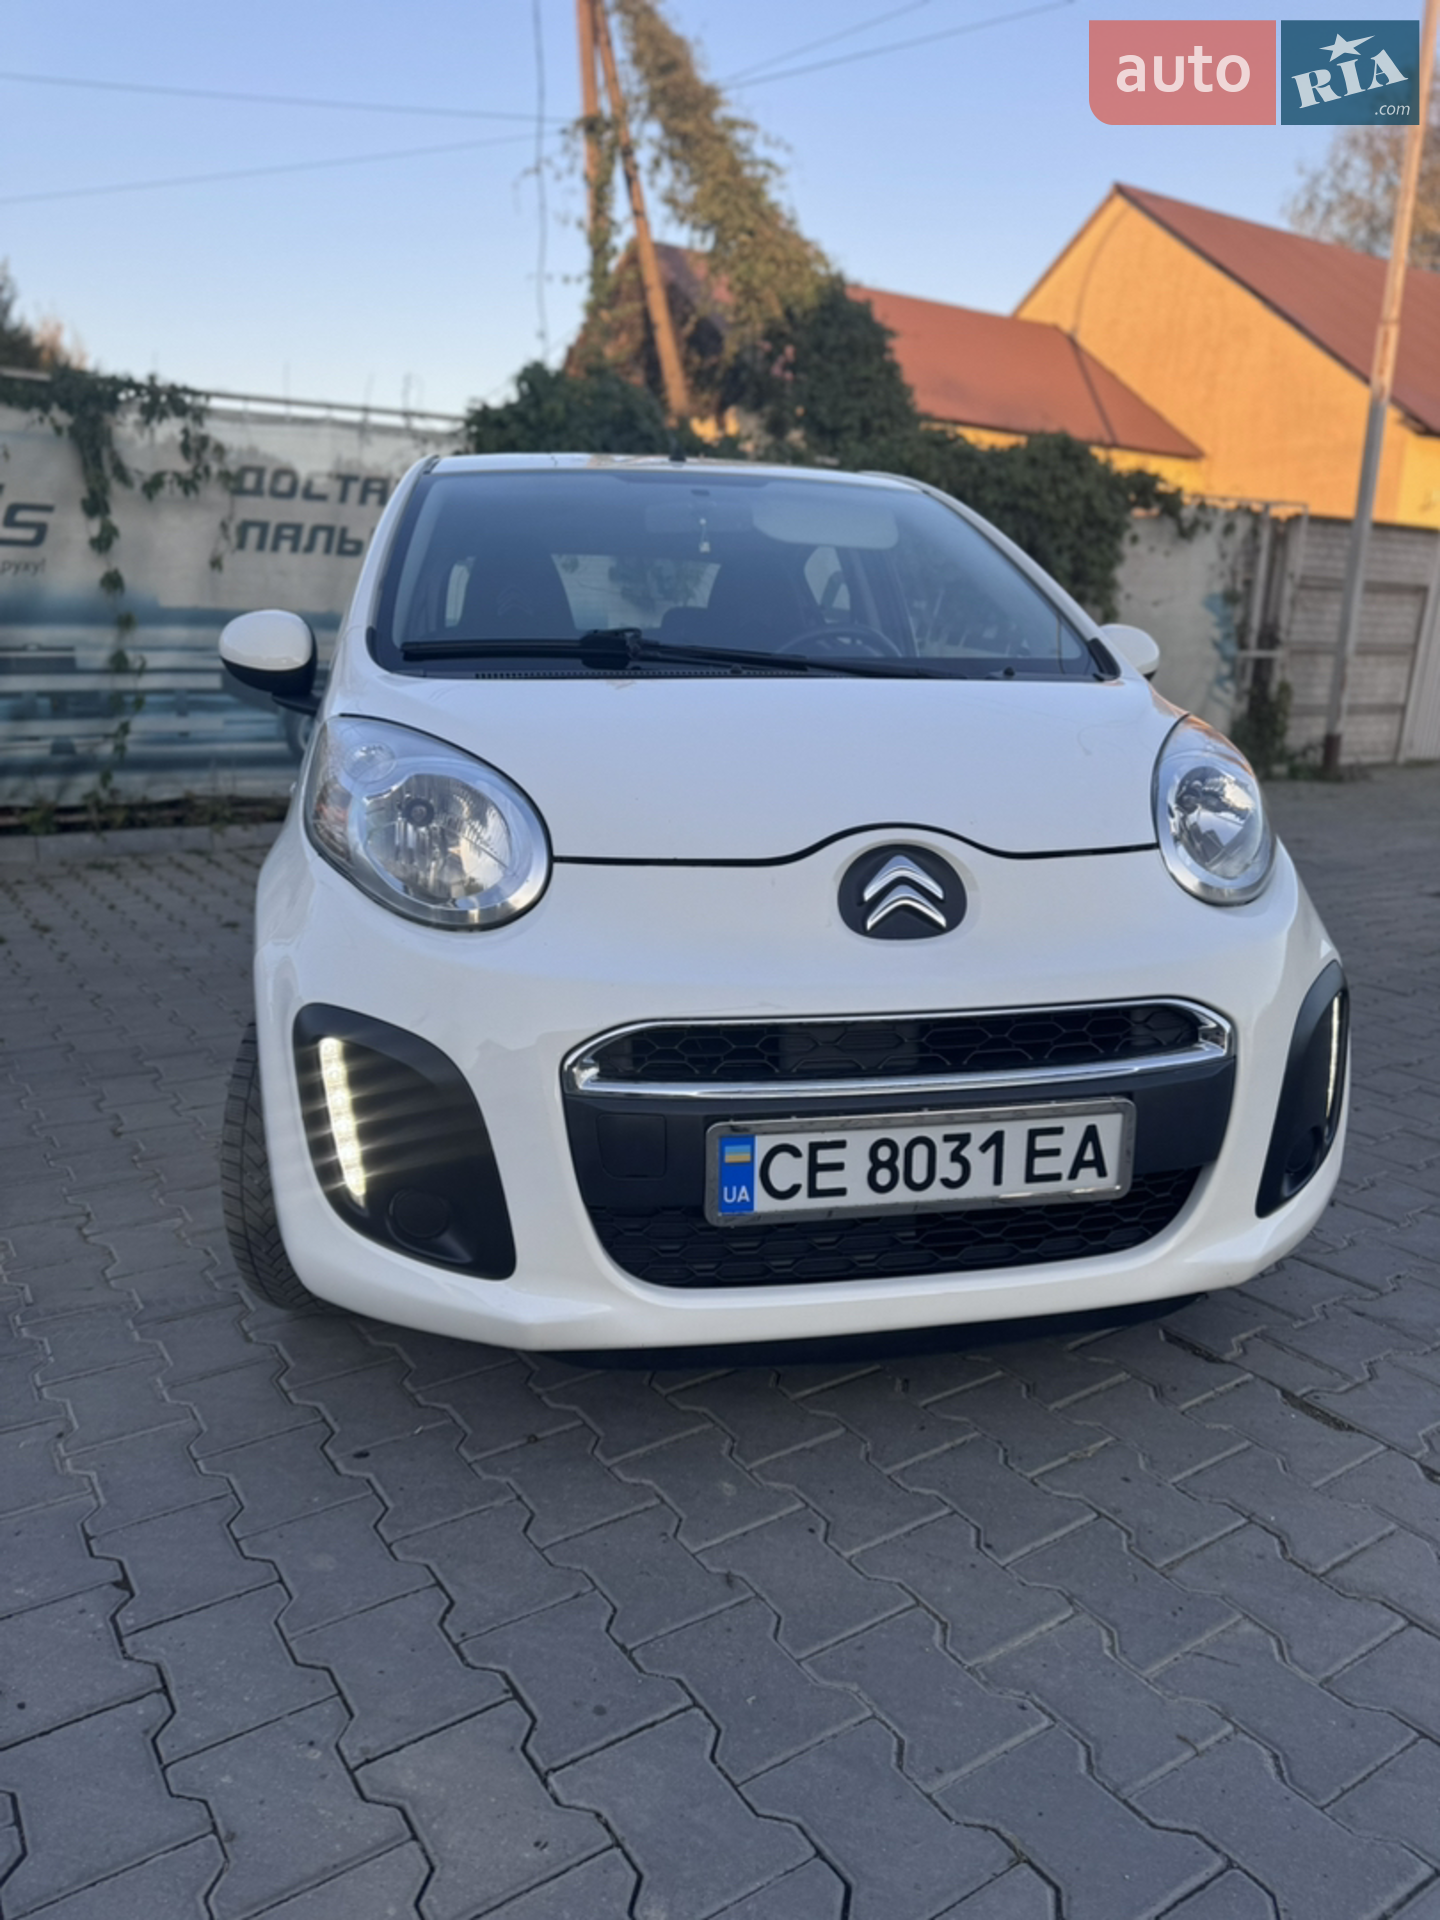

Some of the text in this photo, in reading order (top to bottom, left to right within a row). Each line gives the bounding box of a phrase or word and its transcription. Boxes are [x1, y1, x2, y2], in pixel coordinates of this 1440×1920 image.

[231, 465, 400, 507] ДОСТА
[236, 519, 374, 557] ПАЛЬ
[759, 1124, 1109, 1200] CE 8031 EA
[723, 1185, 751, 1203] UA
